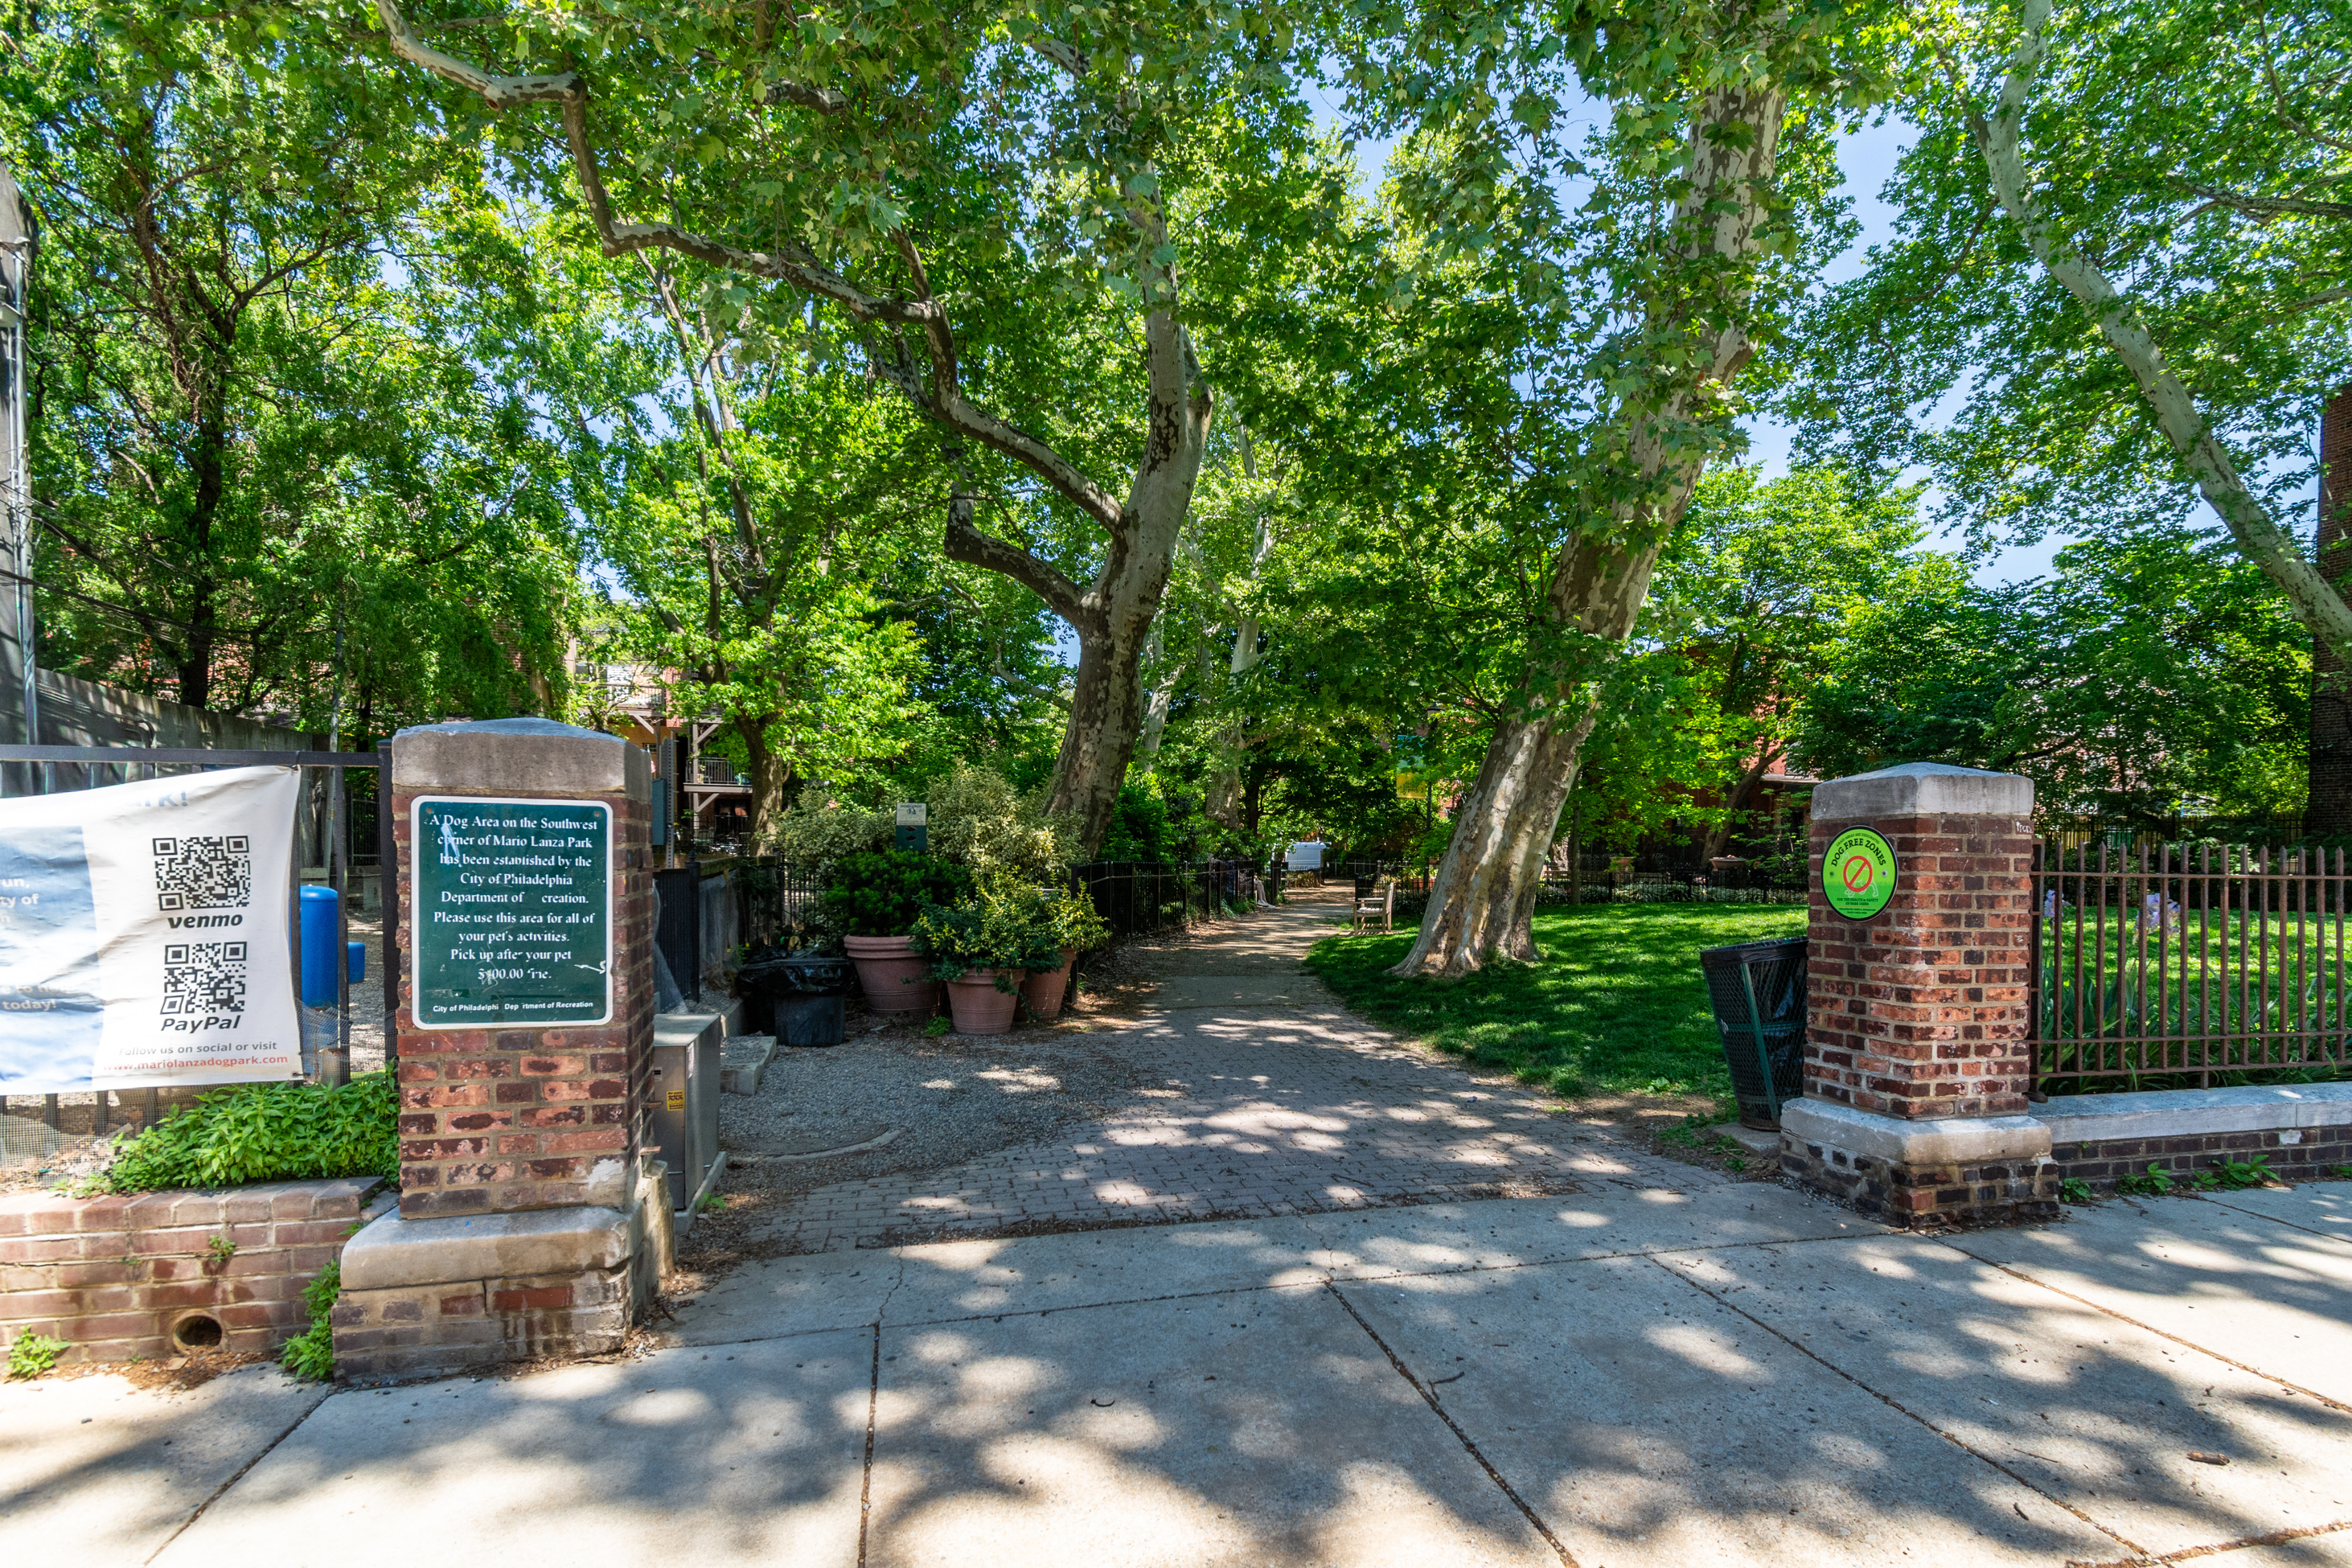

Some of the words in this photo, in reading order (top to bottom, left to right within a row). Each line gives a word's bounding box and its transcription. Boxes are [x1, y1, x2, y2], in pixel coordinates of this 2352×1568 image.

[429, 815, 440, 826] A
[444, 815, 468, 829] Dog
[472, 816, 499, 827] Area
[503, 819, 517, 827] on
[520, 818, 537, 828] the
[540, 817, 597, 830] Southwest
[437, 834, 474, 845] corner
[478, 835, 491, 845] of
[493, 835, 527, 847] Mario
[531, 836, 564, 848] Lanza
[567, 837, 593, 848] Park
[1831, 846, 1845, 867] DOG
[1843, 838, 1864, 851] FREE
[1865, 839, 1886, 866] ZONES
[440, 853, 459, 864] has
[462, 853, 490, 864] been
[493, 855, 555, 867] established
[558, 856, 573, 868] by
[575, 856, 592, 867] the
[0, 878, 30, 889] un,
[460, 872, 484, 886] City
[488, 873, 502, 884] of
[503, 873, 573, 888] Philadelphia
[21, 893, 39, 905] of
[441, 892, 509, 905] Department
[511, 892, 524, 902] of
[541, 893, 589, 904] creation.
[167, 913, 244, 929] venmo
[433, 911, 470, 923] Please
[474, 915, 493, 923] use
[496, 913, 516, 923] this
[519, 915, 544, 923] area
[547, 913, 562, 924] for
[565, 913, 579, 923] all
[582, 913, 596, 924] of
[458, 933, 486, 943] your
[488, 931, 513, 943] pet's
[517, 931, 570, 942] activities.
[450, 949, 476, 960] Pick
[479, 951, 493, 962] up
[526, 951, 552, 962] your
[555, 950, 572, 962] pet
[2, 999, 57, 1012] today!
[433, 1005, 447, 1013] City
[458, 1003, 499, 1012] Philadelphi
[504, 1002, 546, 1011] Deprtment
[556, 1001, 593, 1009] Recreation
[160, 1015, 241, 1034] PayPal
[119, 1047, 156, 1056] Follow
[160, 1045, 174, 1054] us
[178, 1045, 192, 1053] on
[196, 1043, 232, 1053] social
[236, 1043, 248, 1051] or
[252, 1041, 277, 1049] visit
[103, 1055, 288, 1070] www.mariolanzadogpark.com
